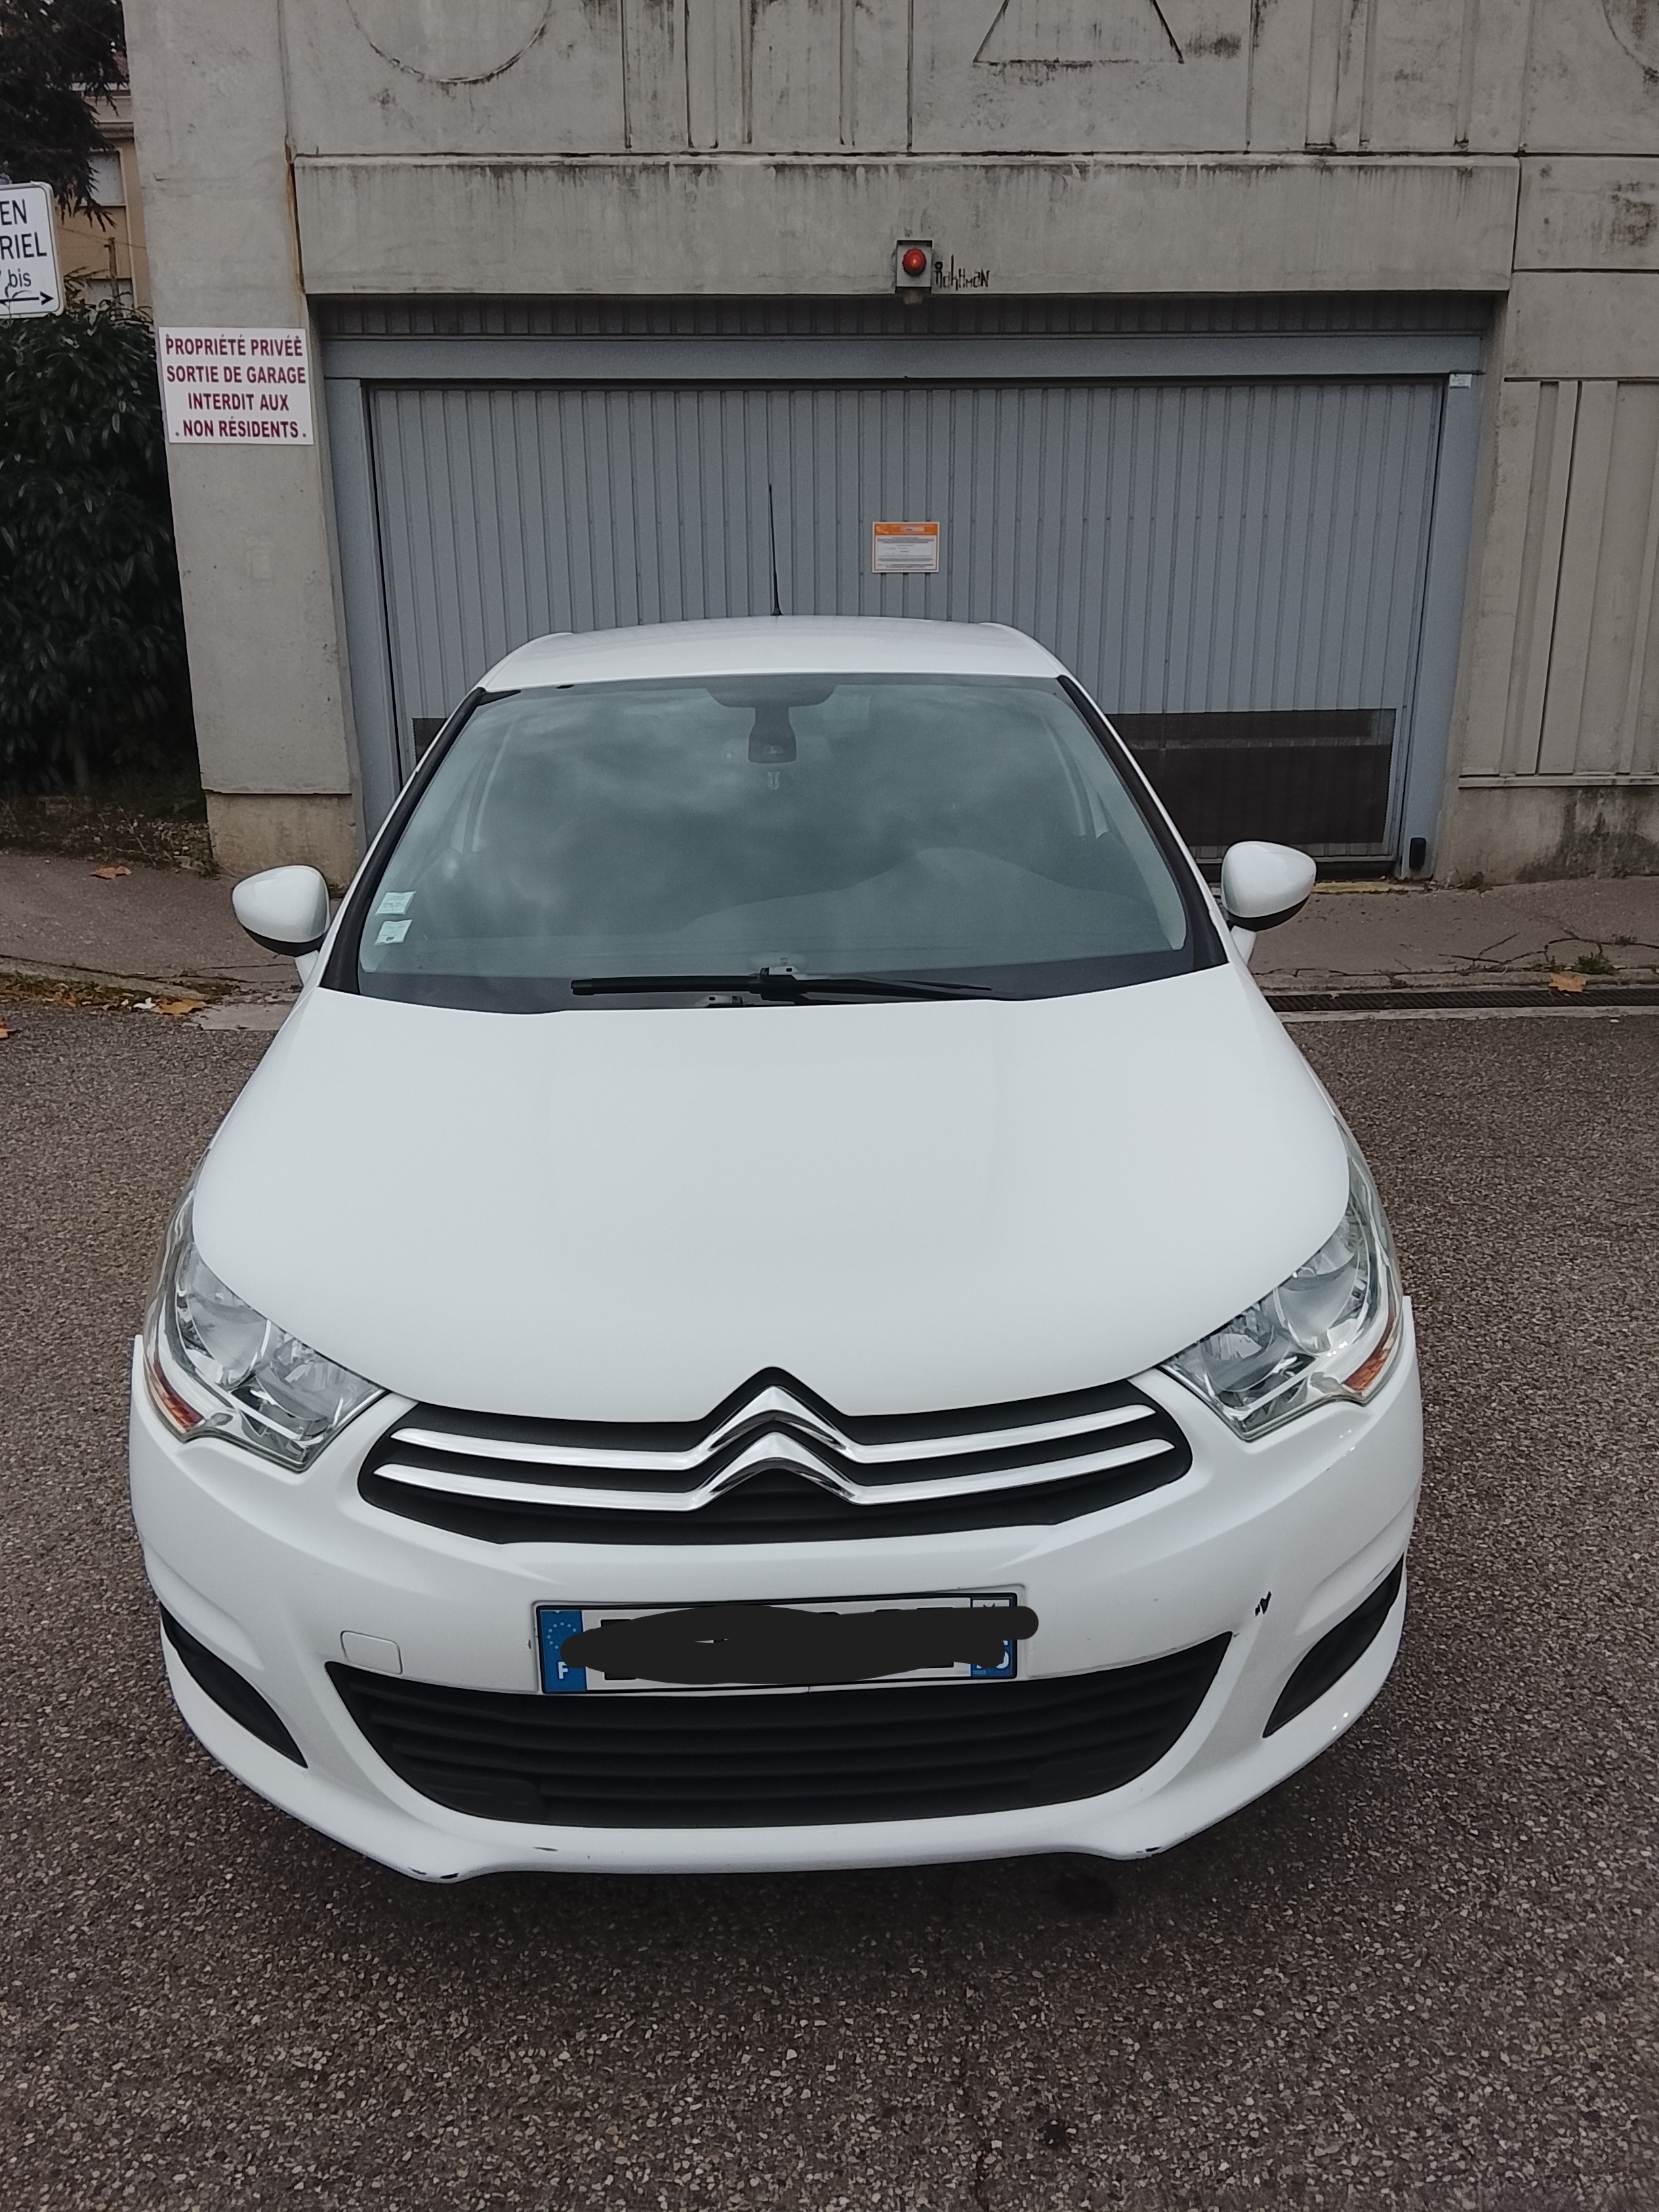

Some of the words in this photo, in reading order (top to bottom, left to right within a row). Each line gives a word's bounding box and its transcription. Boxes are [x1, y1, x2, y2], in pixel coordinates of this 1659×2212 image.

[0, 232, 47, 260] RIEL
[8, 268, 32, 288] bis
[165, 334, 246, 356] PROPRIÉTÉ
[251, 335, 303, 356] PRIVÉE
[167, 365, 219, 383] SORTIE
[224, 367, 242, 383] DE
[247, 367, 306, 384] GARAGE
[188, 393, 254, 410] INTERDIT
[260, 394, 289, 411] AUX
[182, 419, 214, 436] NON
[218, 416, 299, 438] RÉSIDENTS
[558, 1661, 569, 1679] F
